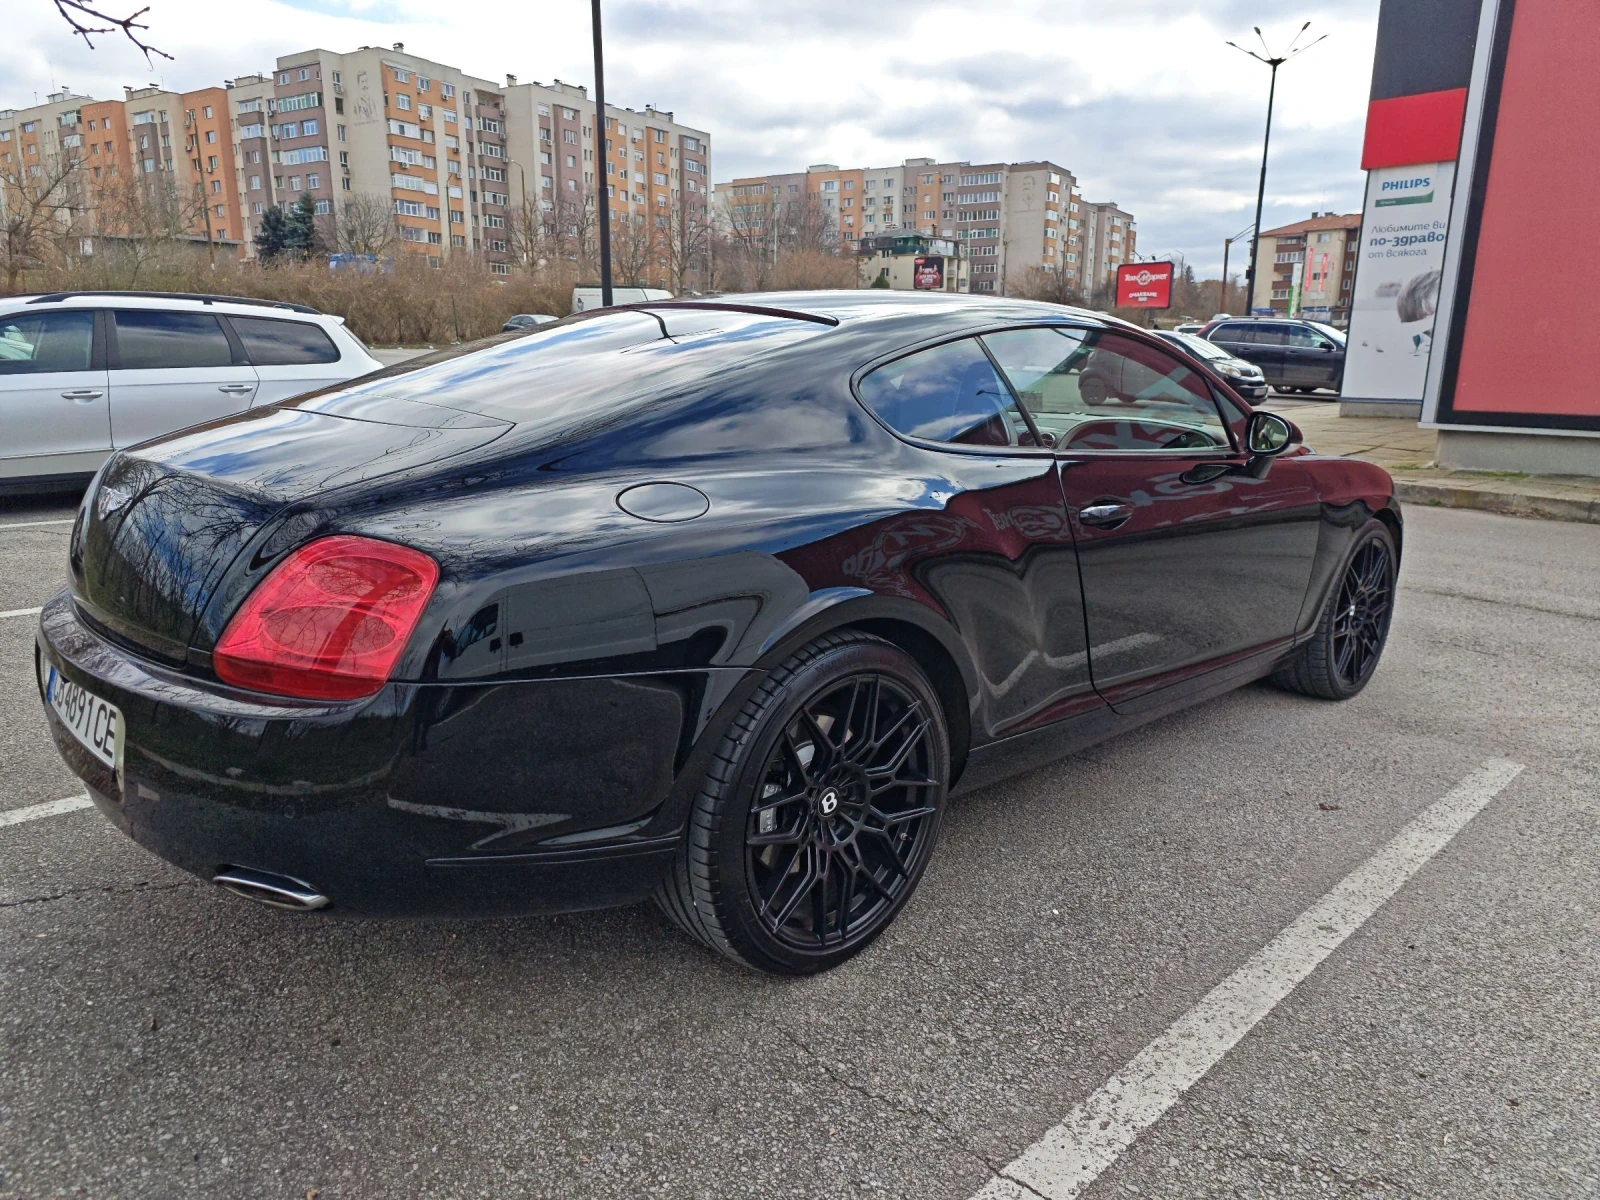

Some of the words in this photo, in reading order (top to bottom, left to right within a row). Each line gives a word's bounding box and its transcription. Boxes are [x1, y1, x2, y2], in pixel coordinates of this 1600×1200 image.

[1382, 178, 1430, 191] PHILIPS
[1371, 223, 1430, 234] Любимите
[1368, 251, 1384, 259] от
[1386, 248, 1427, 258] всякога
[821, 792, 838, 814] B
